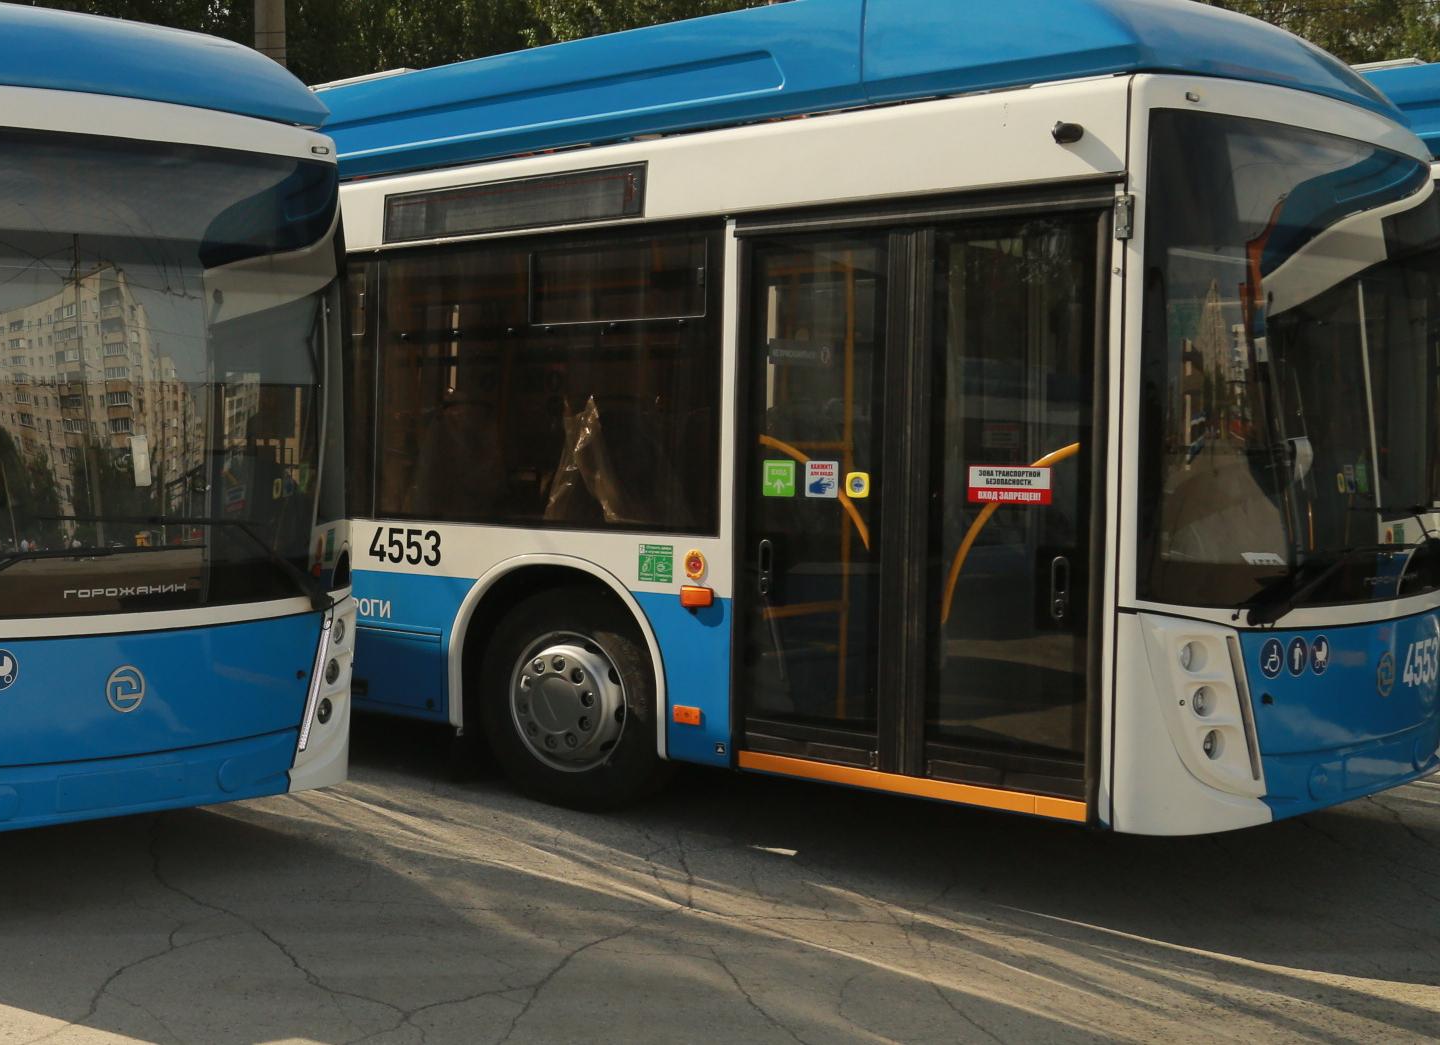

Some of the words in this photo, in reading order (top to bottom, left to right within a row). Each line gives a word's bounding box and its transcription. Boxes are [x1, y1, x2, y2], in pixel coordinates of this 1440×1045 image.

[995, 469, 1041, 478] ТРАНСПОРТНОЙ
[977, 490, 998, 500] ВХОД
[999, 491, 1041, 501] ЗАПРЕЩЕН!
[368, 526, 441, 567] 4553
[63, 583, 187, 599] ГОРОЖАНИН
[1403, 637, 1438, 688] 4553
